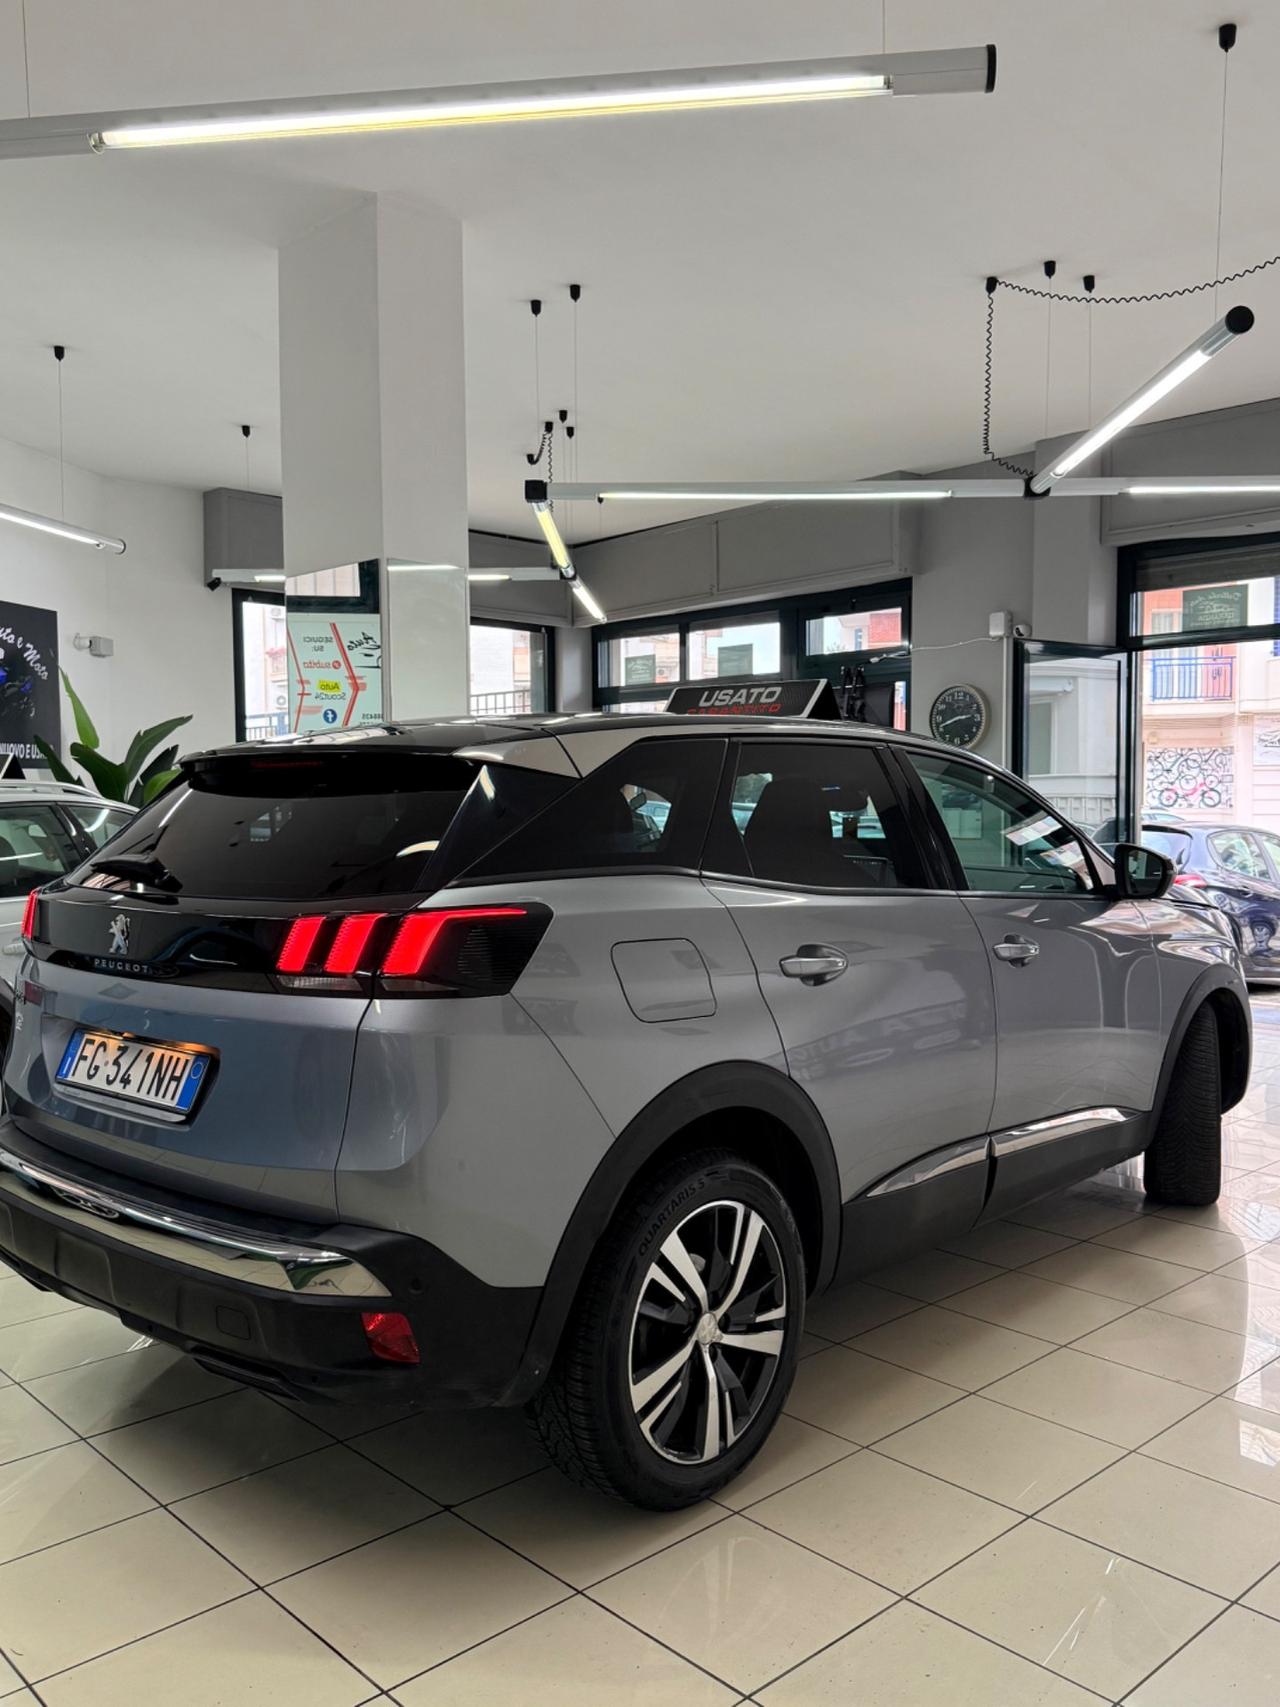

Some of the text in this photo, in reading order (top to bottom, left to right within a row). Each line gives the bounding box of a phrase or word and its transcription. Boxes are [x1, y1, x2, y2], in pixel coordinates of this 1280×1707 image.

[23, 643, 48, 680] Moto
[698, 686, 782, 707] USATO
[94, 958, 149, 973] PEUGEOT
[71, 1038, 107, 1081] FG
[106, 1045, 191, 1101] 341NH
[639, 1183, 697, 1256] QUARTARIS
